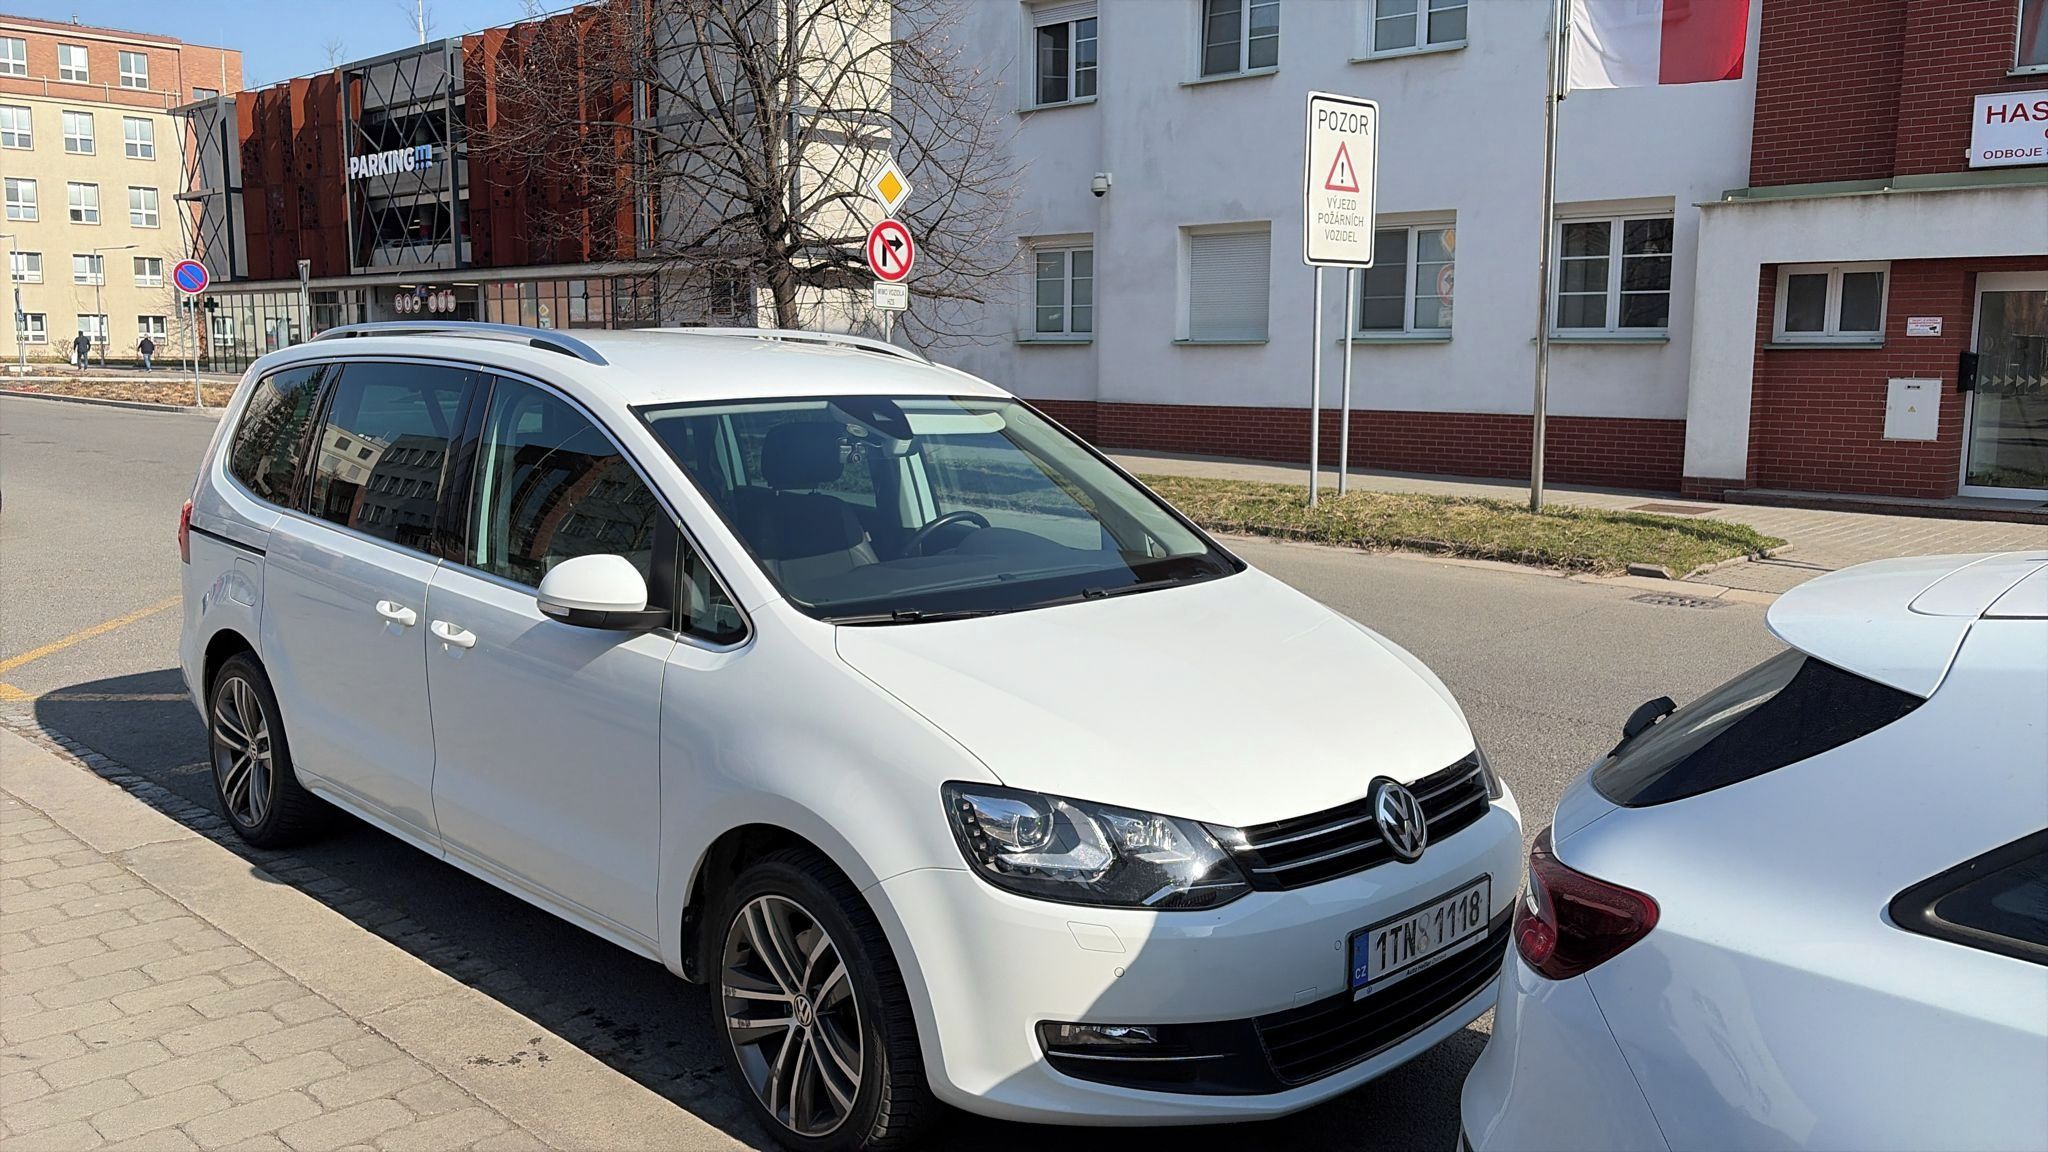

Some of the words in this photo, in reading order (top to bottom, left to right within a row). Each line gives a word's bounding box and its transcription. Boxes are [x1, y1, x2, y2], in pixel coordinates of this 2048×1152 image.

[1986, 101, 2048, 124] HAS
[1318, 109, 1369, 135] POZOR
[1983, 147, 2043, 160] ODBOJE
[1327, 196, 1357, 211] VÝJEZD
[1318, 212, 1365, 228] POŽÁRNÍCH
[1325, 229, 1358, 243] VOZIDEL
[1355, 965, 1367, 979] CZ
